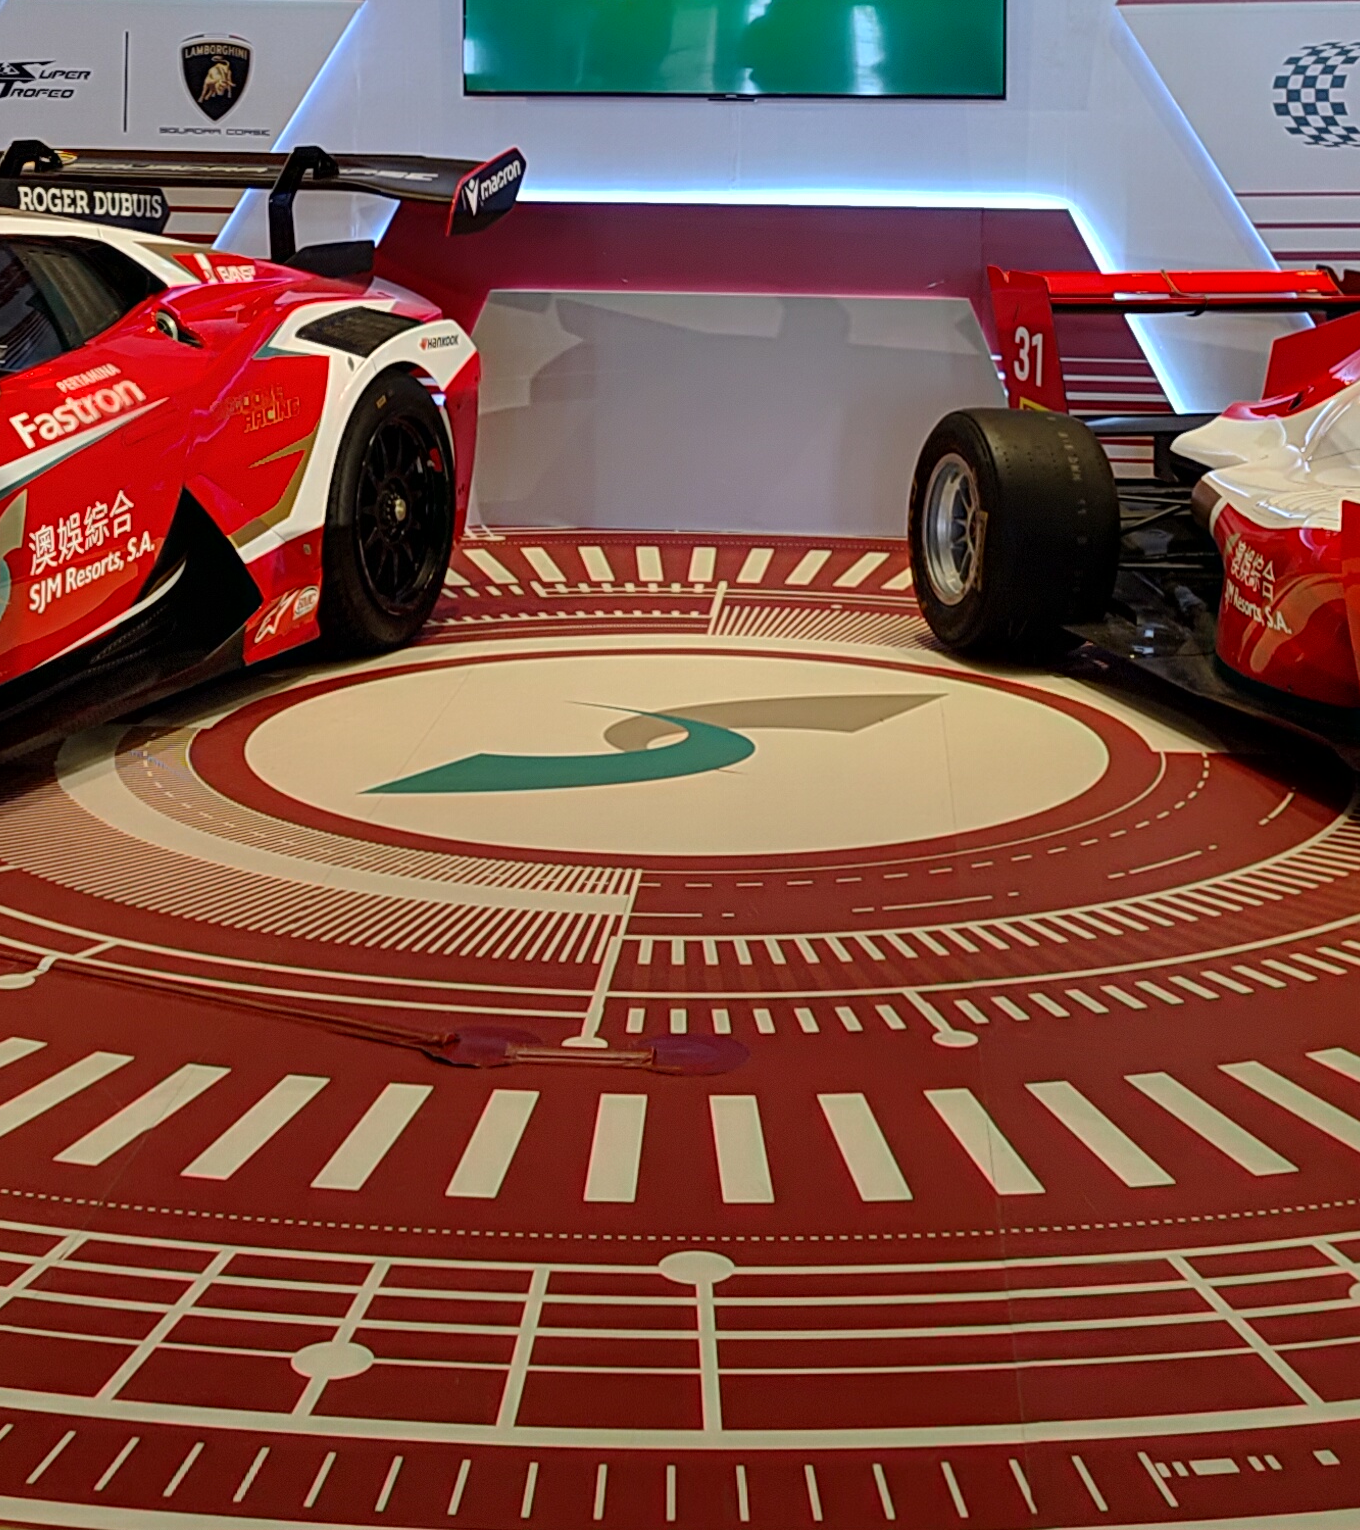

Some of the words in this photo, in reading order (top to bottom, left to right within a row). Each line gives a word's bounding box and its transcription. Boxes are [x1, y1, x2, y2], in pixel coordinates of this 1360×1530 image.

[184, 44, 248, 61] LAMBORGHINI
[17, 185, 90, 214] ROGER
[94, 189, 163, 219] DUBUIS
[481, 159, 521, 201] macron
[55, 363, 121, 394] PERTAMINA
[1014, 325, 1043, 387] 31
[9, 379, 147, 449] Fastron
[28, 489, 134, 576] 澳娛綜合
[29, 572, 62, 614] SJM
[65, 551, 125, 594] Resorts,
[127, 530, 156, 562] S.A.
